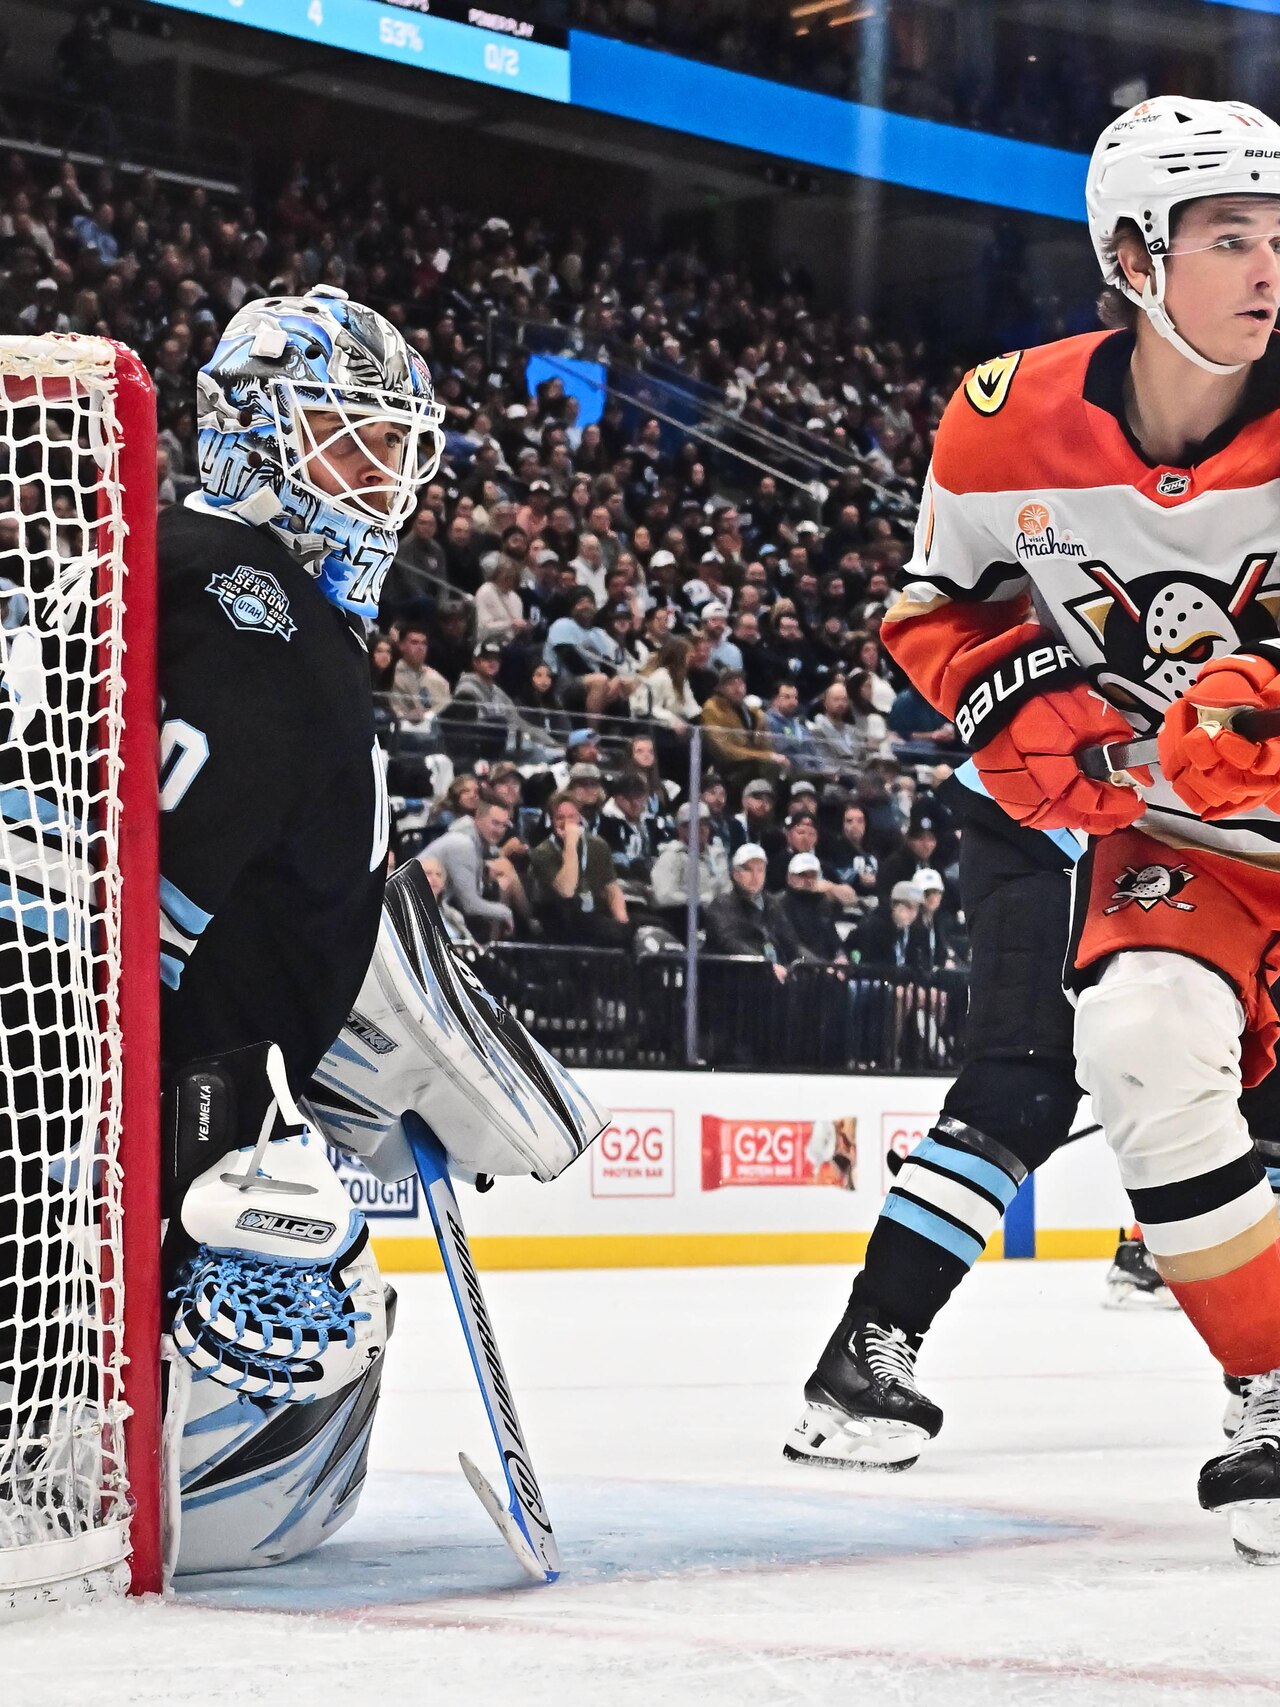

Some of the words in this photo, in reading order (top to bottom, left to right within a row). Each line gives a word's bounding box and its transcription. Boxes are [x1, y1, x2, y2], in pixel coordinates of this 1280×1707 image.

[379, 17, 424, 52] 53%
[485, 43, 519, 76] 0/2
[1163, 480, 1184, 492] NHL
[1015, 526, 1087, 560] Anaheim
[1028, 535, 1045, 543] visit
[221, 579, 242, 594] 2024
[235, 573, 285, 612] SEASON
[240, 568, 286, 604] INAUGURAL
[238, 600, 263, 619] UTAH
[268, 607, 288, 625] 2025
[197, 1084, 212, 1142] VEJMELKA
[601, 1127, 663, 1161] G2G
[734, 1126, 793, 1163] G2G
[645, 1168, 663, 1178] BAR
[446, 1210, 524, 1454] WARRIOR
